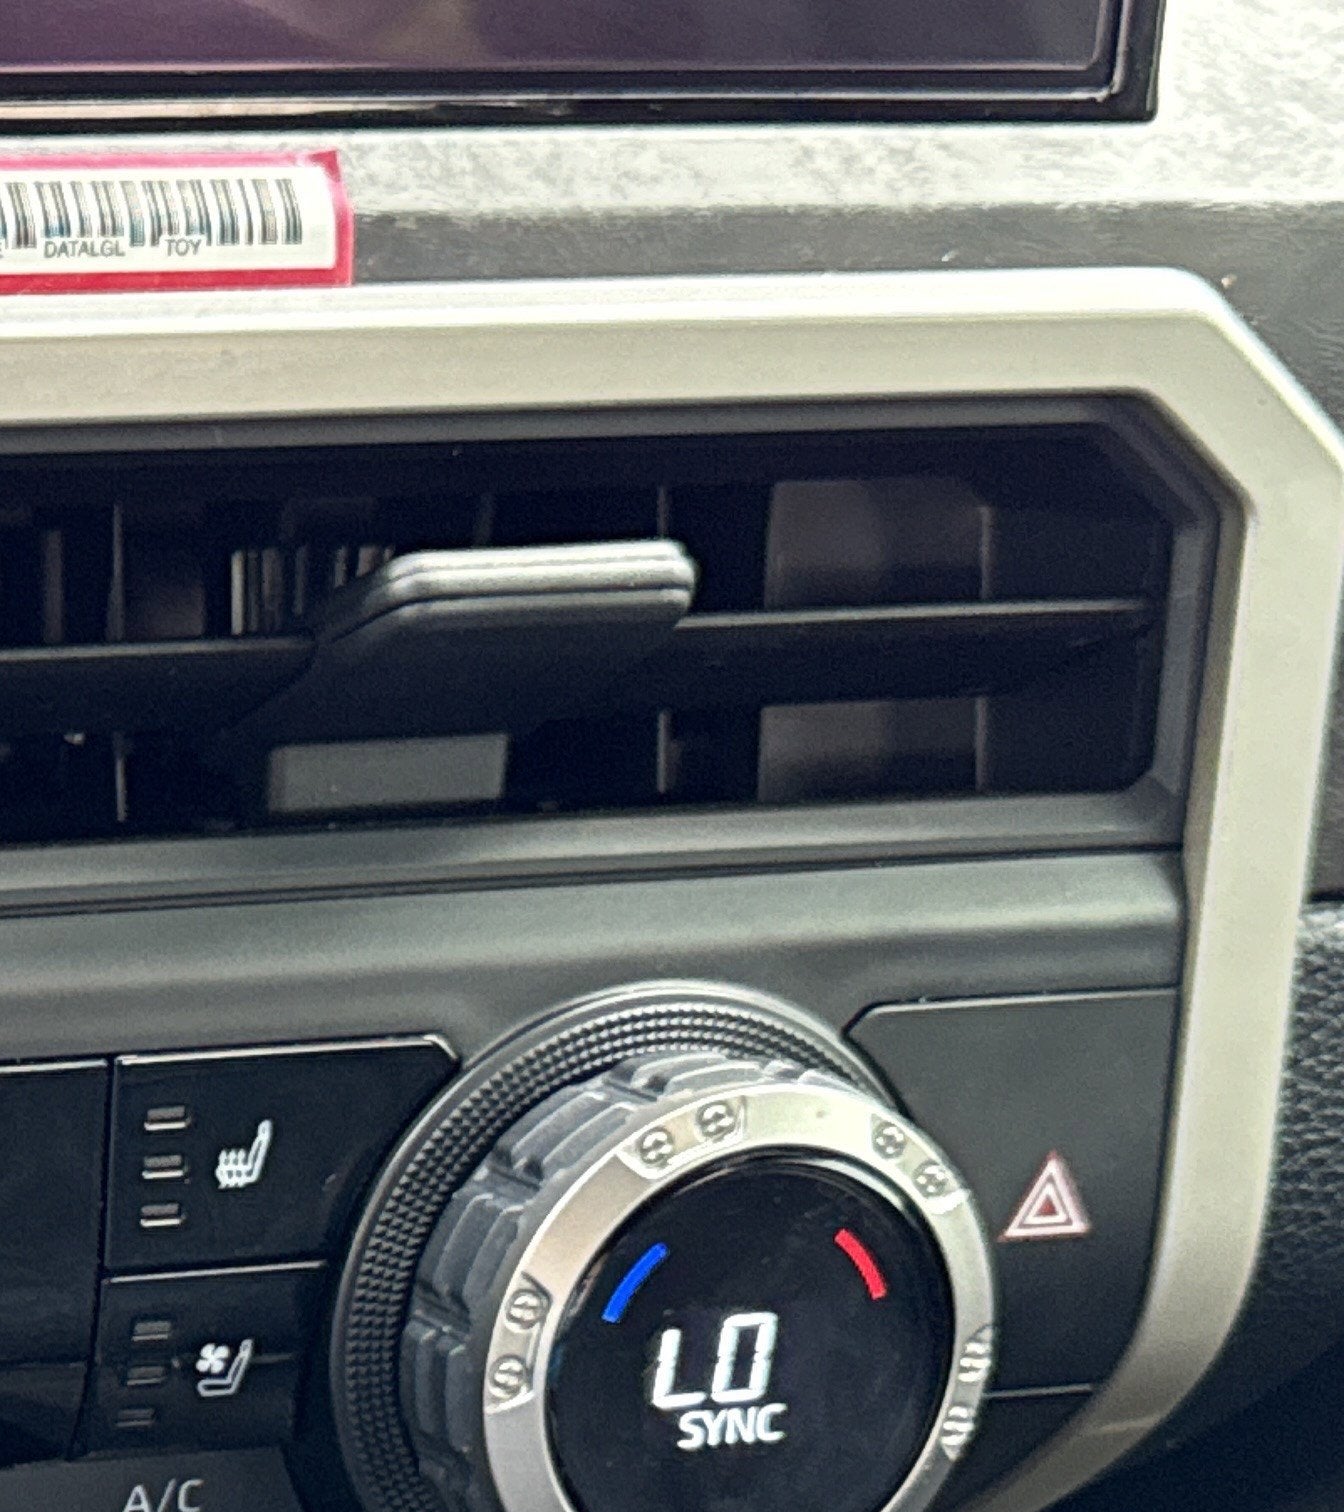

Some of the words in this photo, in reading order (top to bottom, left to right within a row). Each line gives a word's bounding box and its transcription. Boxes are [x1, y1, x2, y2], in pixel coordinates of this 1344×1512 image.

[43, 239, 125, 258] DATALGL
[164, 238, 202, 257] TOY
[676, 1402, 785, 1451] SYNC
